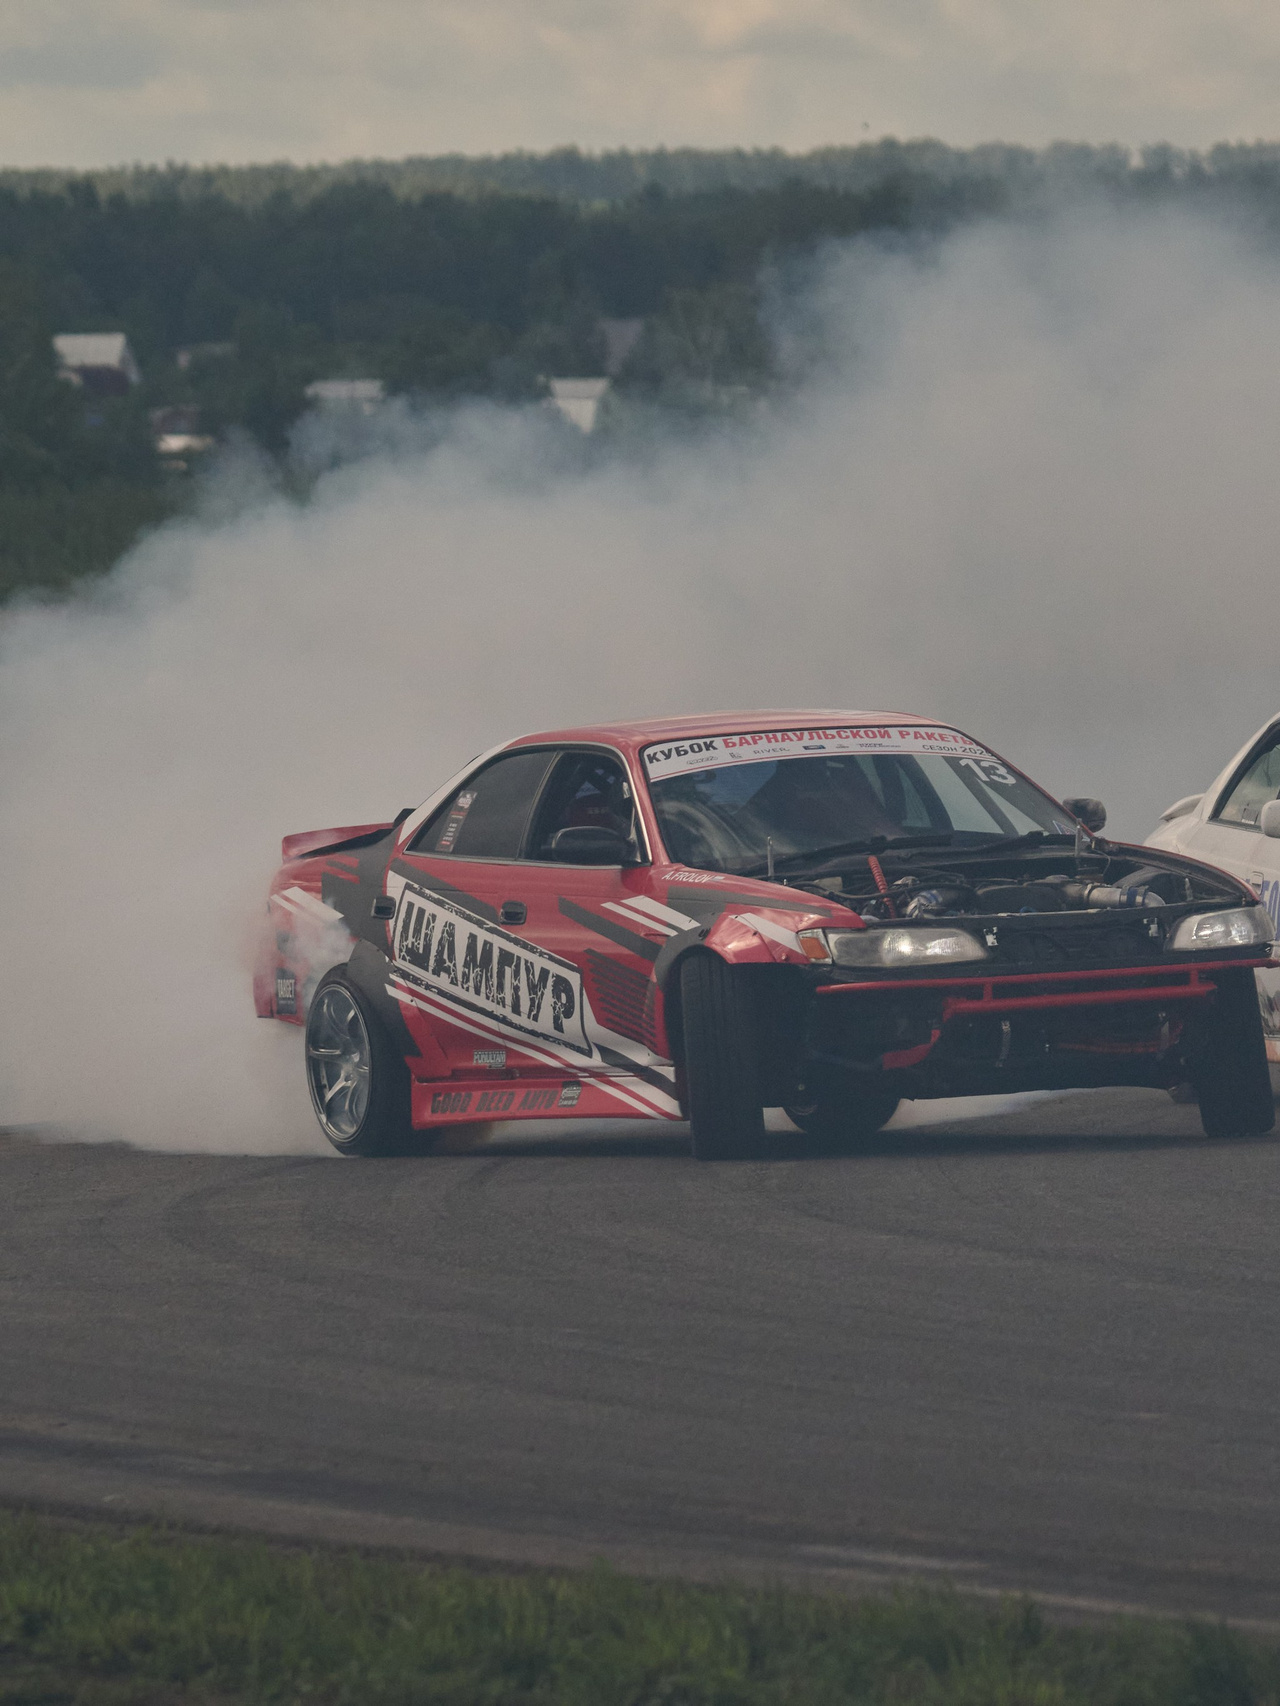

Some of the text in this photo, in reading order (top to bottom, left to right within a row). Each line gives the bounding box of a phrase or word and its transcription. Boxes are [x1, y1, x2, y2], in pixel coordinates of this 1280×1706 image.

[646, 740, 718, 765] КУБОК
[722, 727, 892, 749] БАРНАУЛЬСКОЙ
[922, 744, 992, 757] СЕЗОН 202
[959, 758, 1017, 785] 13
[661, 870, 713, 884] A.FROLOV
[399, 900, 576, 1034] ШАМПУР
[430, 1091, 473, 1115] GOOD
[517, 1088, 560, 1112] AUTO
